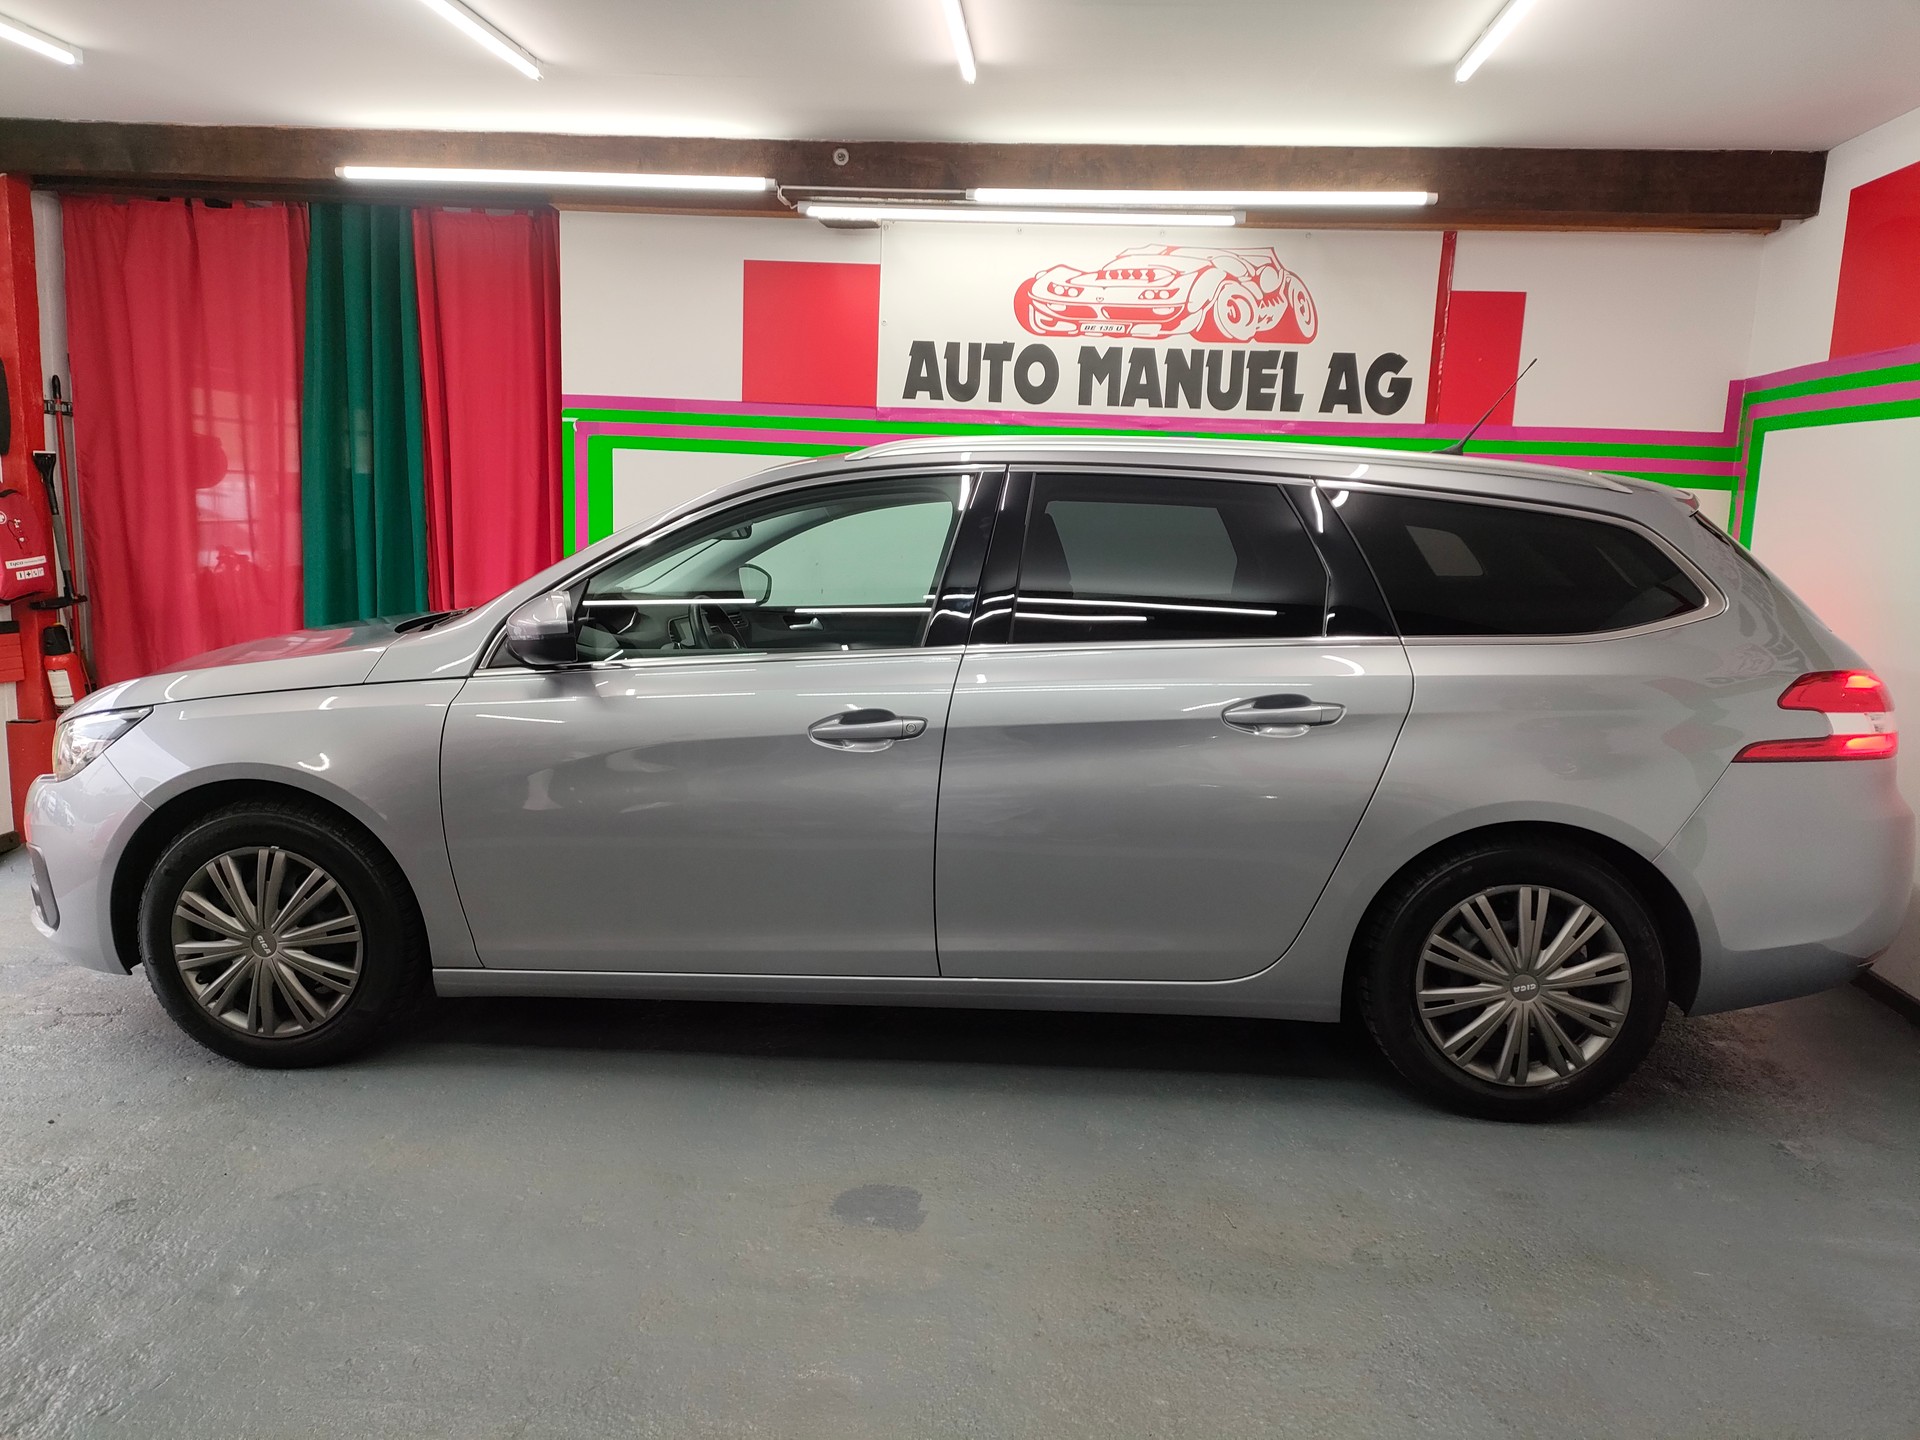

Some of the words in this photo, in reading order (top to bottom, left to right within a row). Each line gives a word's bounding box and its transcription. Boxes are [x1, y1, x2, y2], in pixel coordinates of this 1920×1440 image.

[903, 341, 1059, 404] AUTO
[1078, 347, 1304, 412] MANUEL
[1319, 352, 1412, 415] AG
[1513, 983, 1537, 993] GIGA
